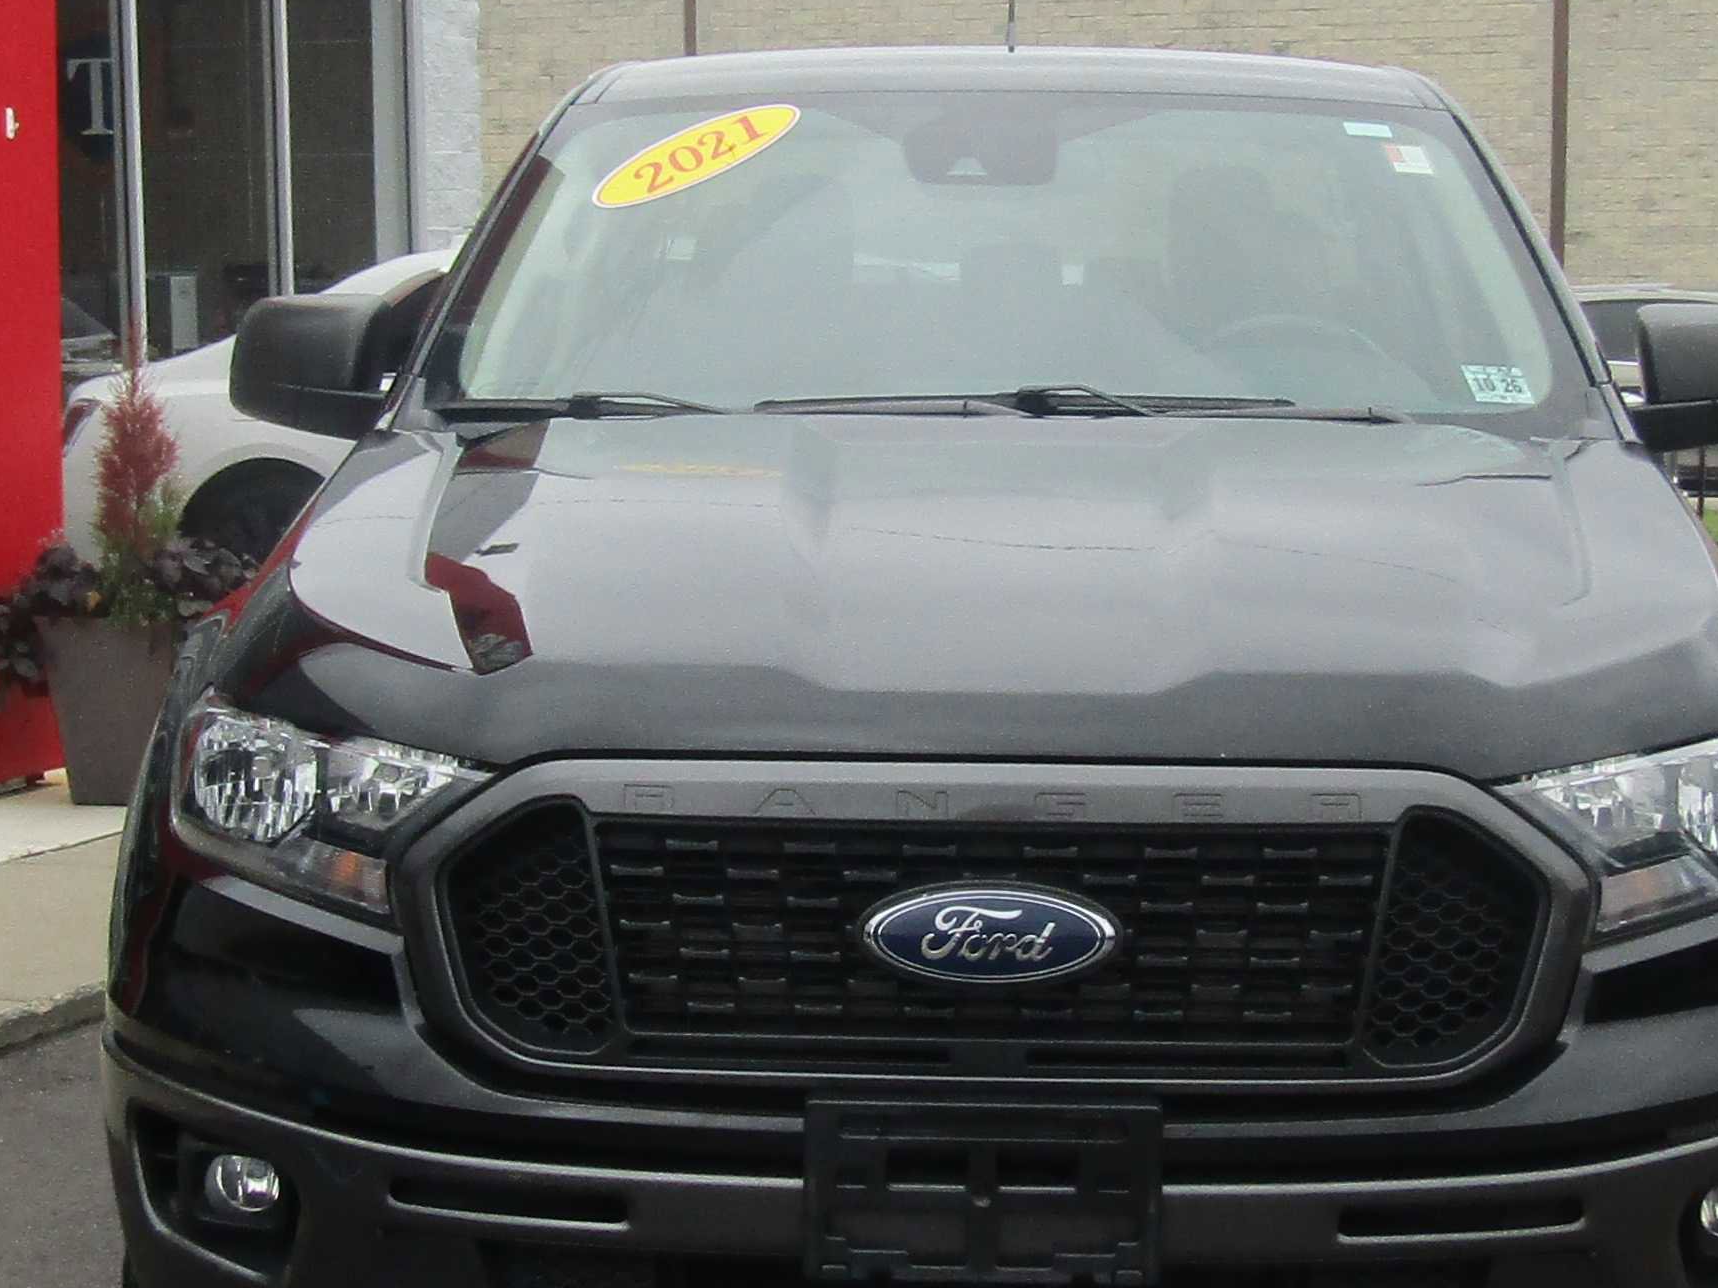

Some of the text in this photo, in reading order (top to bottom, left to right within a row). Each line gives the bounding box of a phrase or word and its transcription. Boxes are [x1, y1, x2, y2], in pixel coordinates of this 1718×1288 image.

[633, 114, 766, 194] 2021
[622, 782, 1364, 821] RANGER
[920, 905, 1056, 962] Ford
